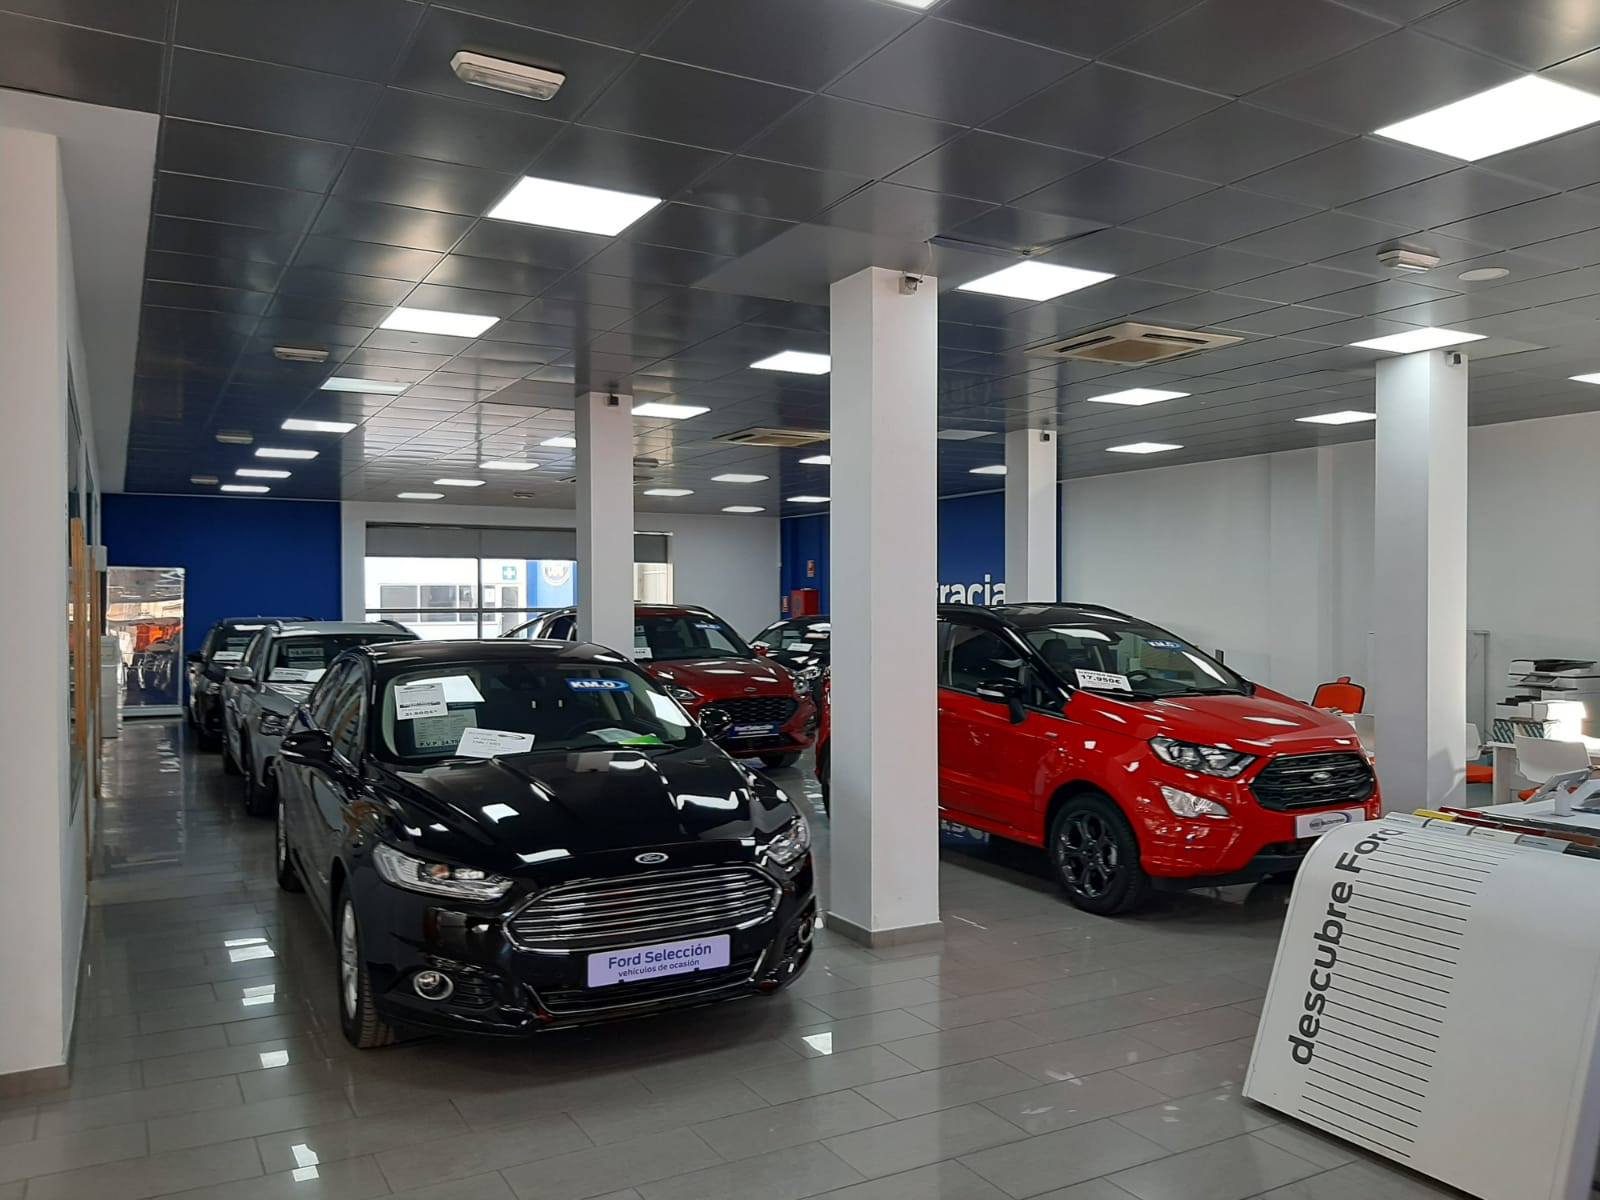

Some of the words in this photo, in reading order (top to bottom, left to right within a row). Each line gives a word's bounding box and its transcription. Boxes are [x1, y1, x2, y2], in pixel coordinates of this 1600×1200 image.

[937, 574, 1005, 605] racia
[609, 953, 641, 968] Ford
[645, 944, 711, 963] Selección
[618, 966, 657, 977] vehículos
[657, 963, 668, 972] de
[669, 959, 700, 970] ocasión
[1287, 881, 1354, 1066] descubre
